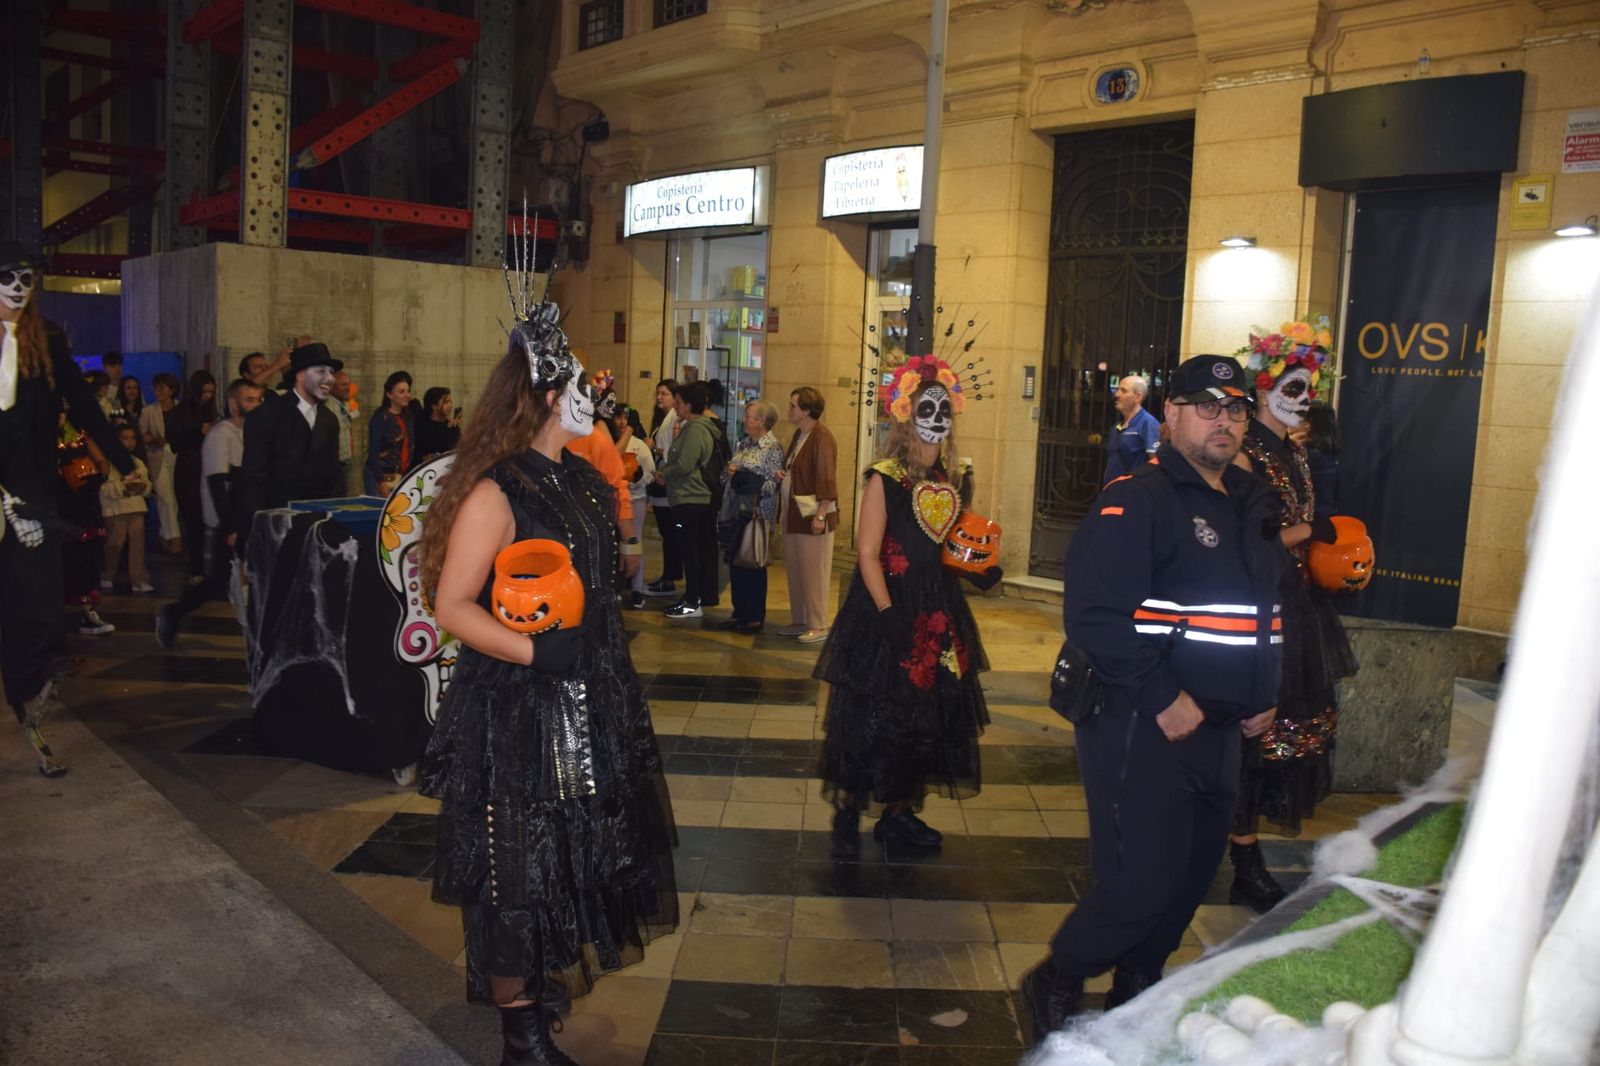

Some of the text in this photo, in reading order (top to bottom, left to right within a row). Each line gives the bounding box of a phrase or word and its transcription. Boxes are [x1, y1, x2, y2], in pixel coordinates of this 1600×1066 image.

[1110, 78, 1124, 94] 13
[1567, 135, 1600, 145] Alarm
[633, 194, 745, 224] Campus Centro
[1357, 321, 1450, 362] OVS
[1371, 367, 1396, 375] LOVE
[1400, 368, 1444, 376] PEOPLE.
[1447, 369, 1465, 377] NOT
[1390, 569, 1430, 583] ITALIAN
